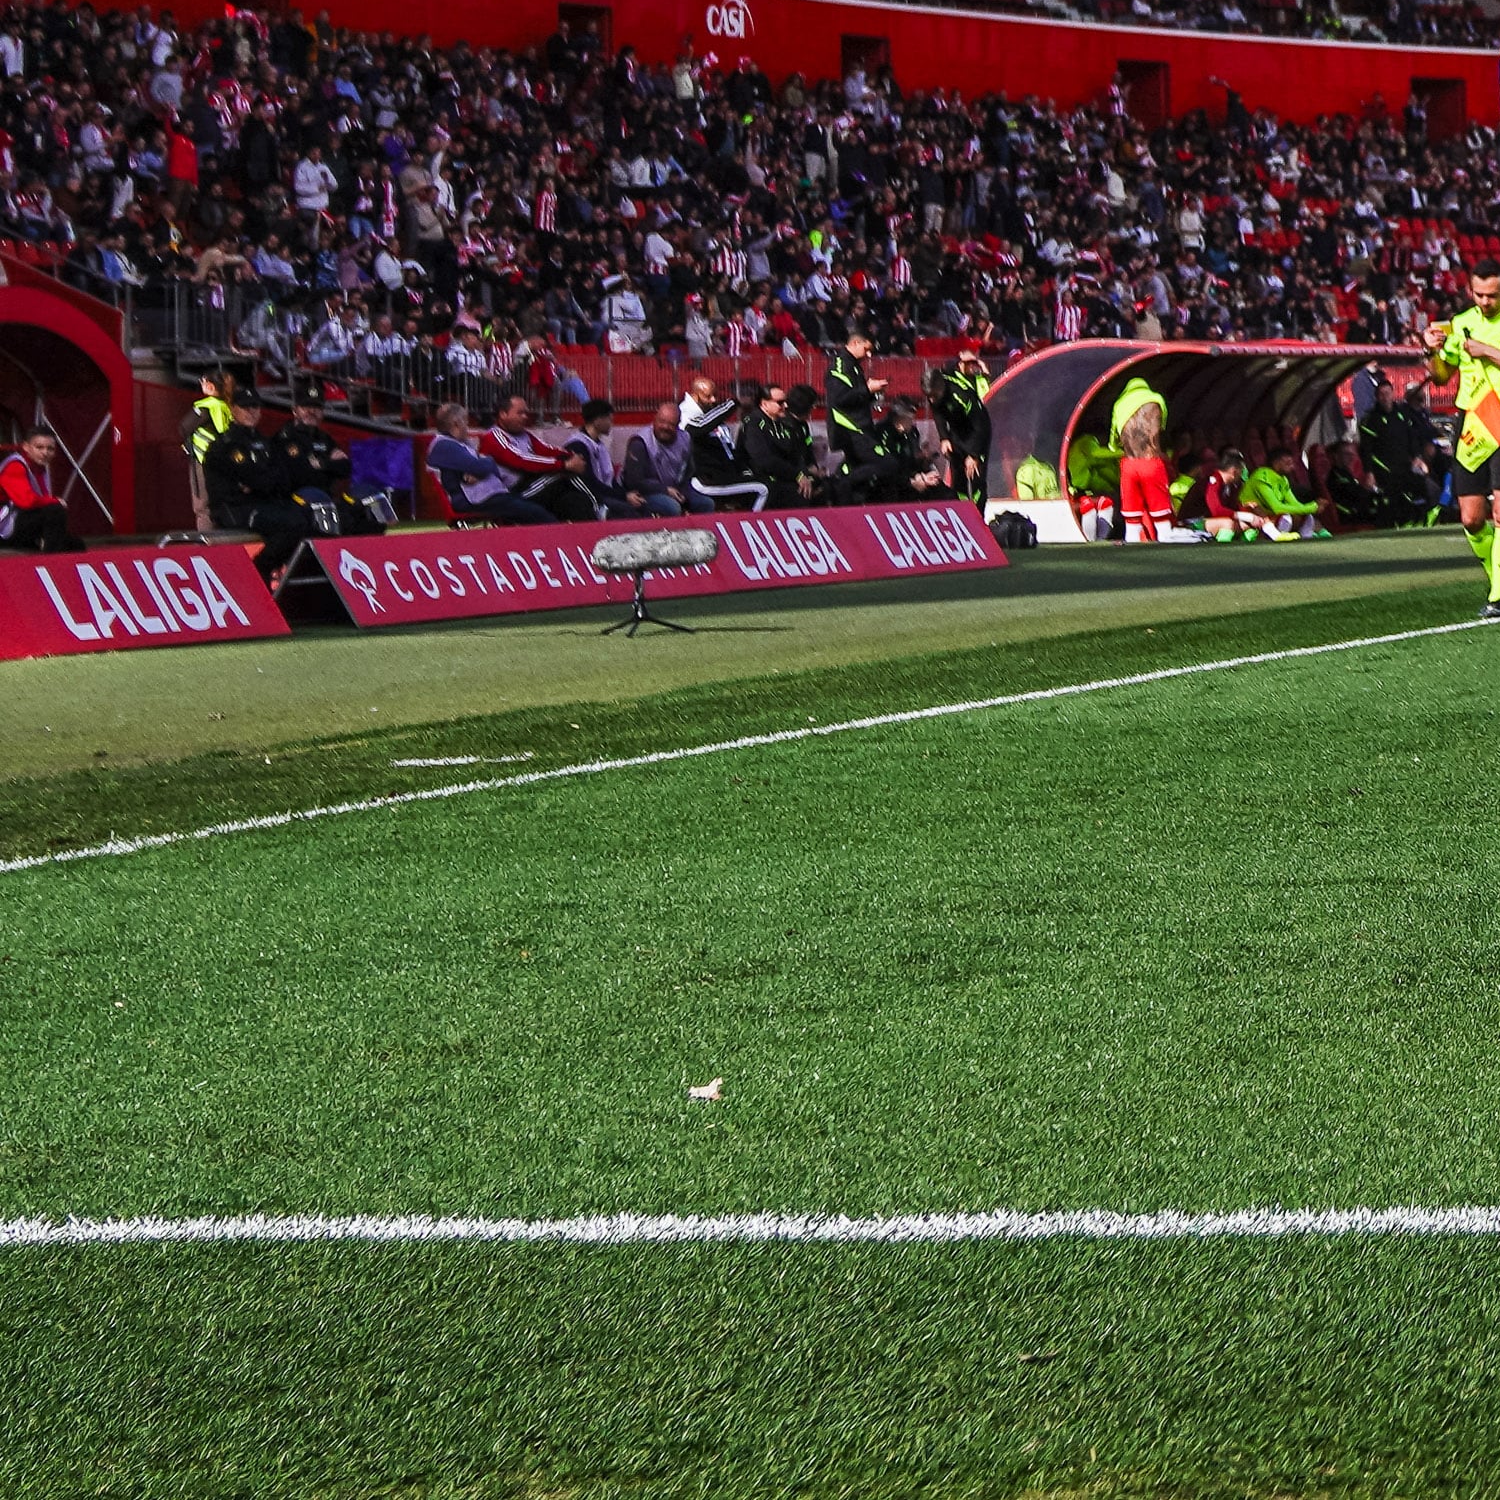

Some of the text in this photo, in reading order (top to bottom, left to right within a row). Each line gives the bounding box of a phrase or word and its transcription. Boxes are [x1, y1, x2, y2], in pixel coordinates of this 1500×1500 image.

[715, 515, 853, 582] LALIGA
[864, 507, 988, 570] LALIGA
[35, 555, 251, 642] LALIGA
